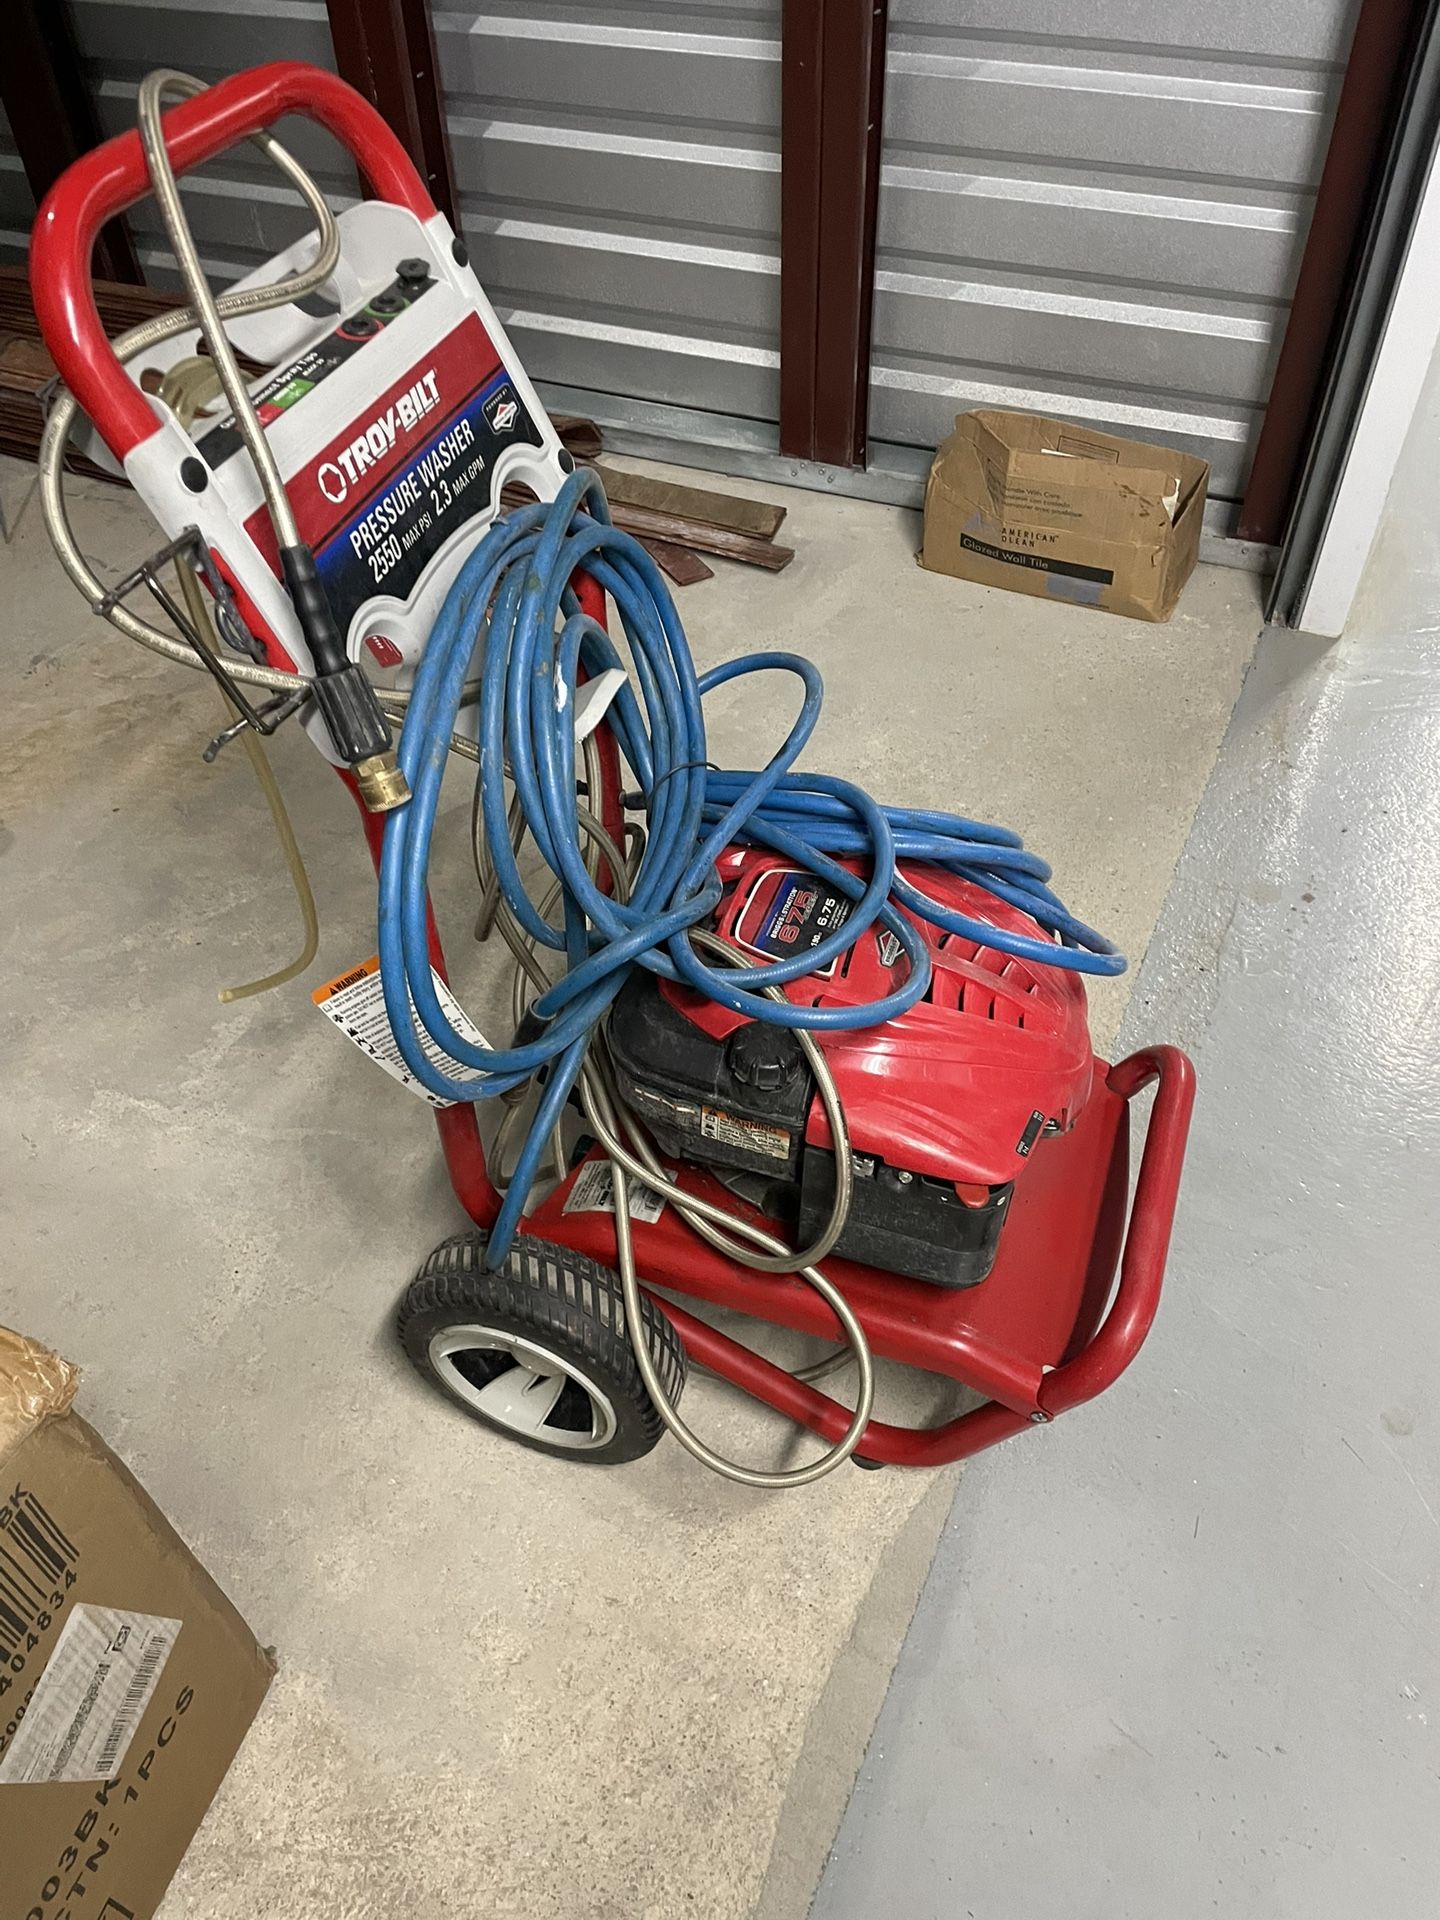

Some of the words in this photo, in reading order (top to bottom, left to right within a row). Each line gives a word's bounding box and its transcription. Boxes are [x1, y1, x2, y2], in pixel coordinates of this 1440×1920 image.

[337, 369, 440, 485] TROY-BILT
[349, 472, 422, 559] PRESSURE
[416, 418, 475, 488] WASHER
[368, 534, 402, 584] 2550
[401, 524, 422, 551] MAX
[418, 511, 433, 533] PSI
[430, 480, 452, 517] 2.3
[452, 471, 469, 496] MAX
[468, 454, 486, 479] GPM
[963, 537, 1000, 558] Glazed
[1001, 552, 1026, 565] Wall
[1029, 558, 1049, 569] Tile
[1001, 535, 1035, 548] OLEAN
[778, 890, 814, 944] 675
[817, 898, 836, 926] 6.75
[334, 968, 369, 992] WARNING
[727, 1113, 776, 1133] WARNING
